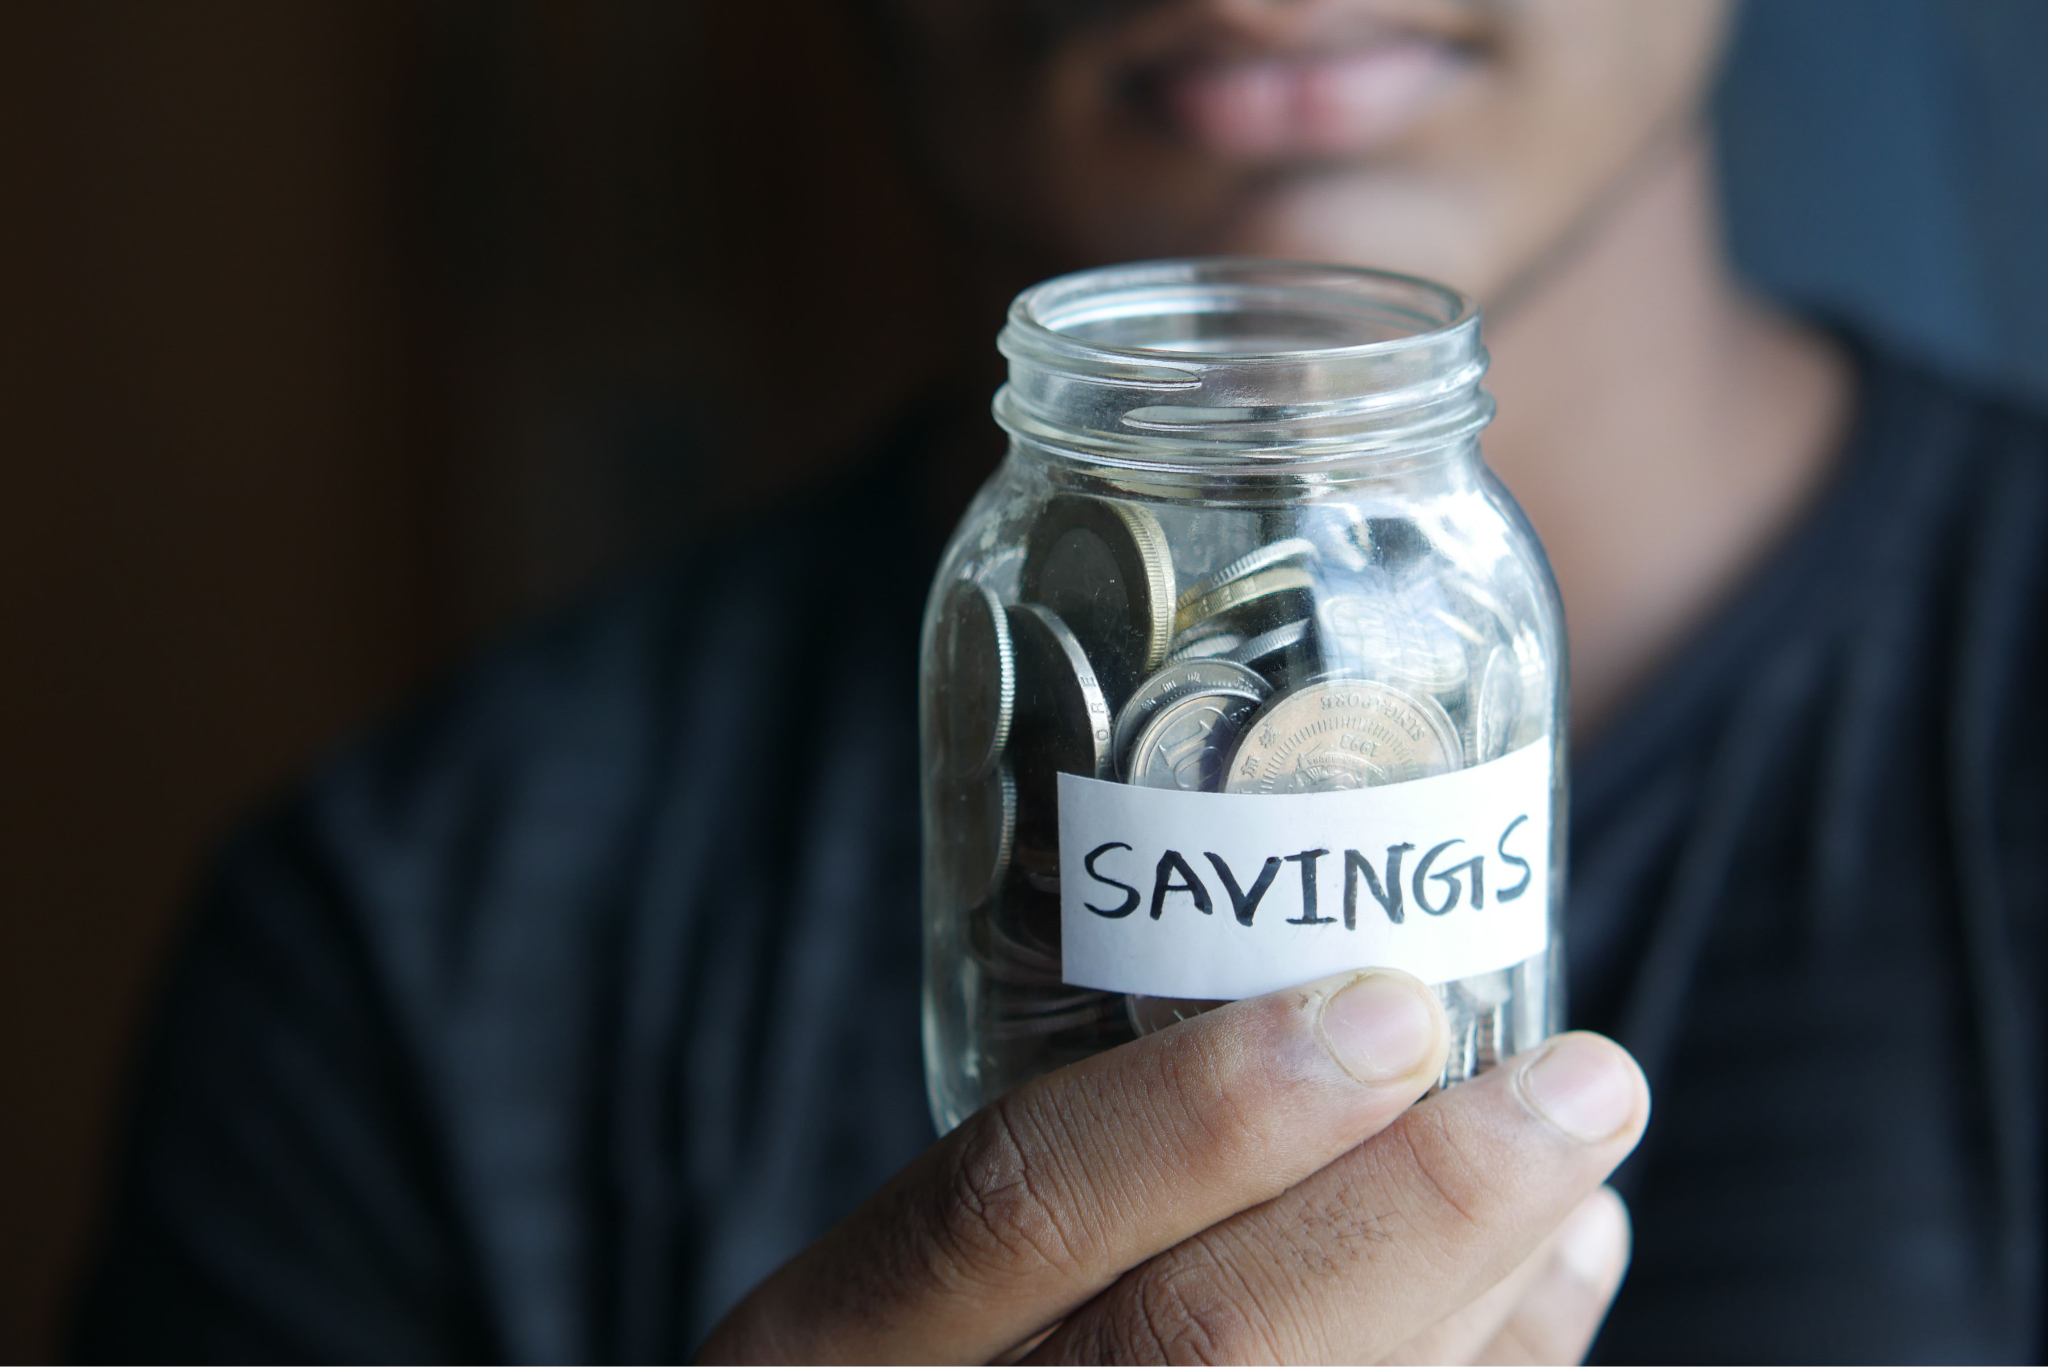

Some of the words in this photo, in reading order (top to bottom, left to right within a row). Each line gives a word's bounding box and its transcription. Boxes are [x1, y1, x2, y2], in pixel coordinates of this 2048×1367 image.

[1320, 692, 1427, 743] SINGAPORE
[1339, 732, 1382, 758] 1993
[1083, 814, 1532, 931] SAVINGS
